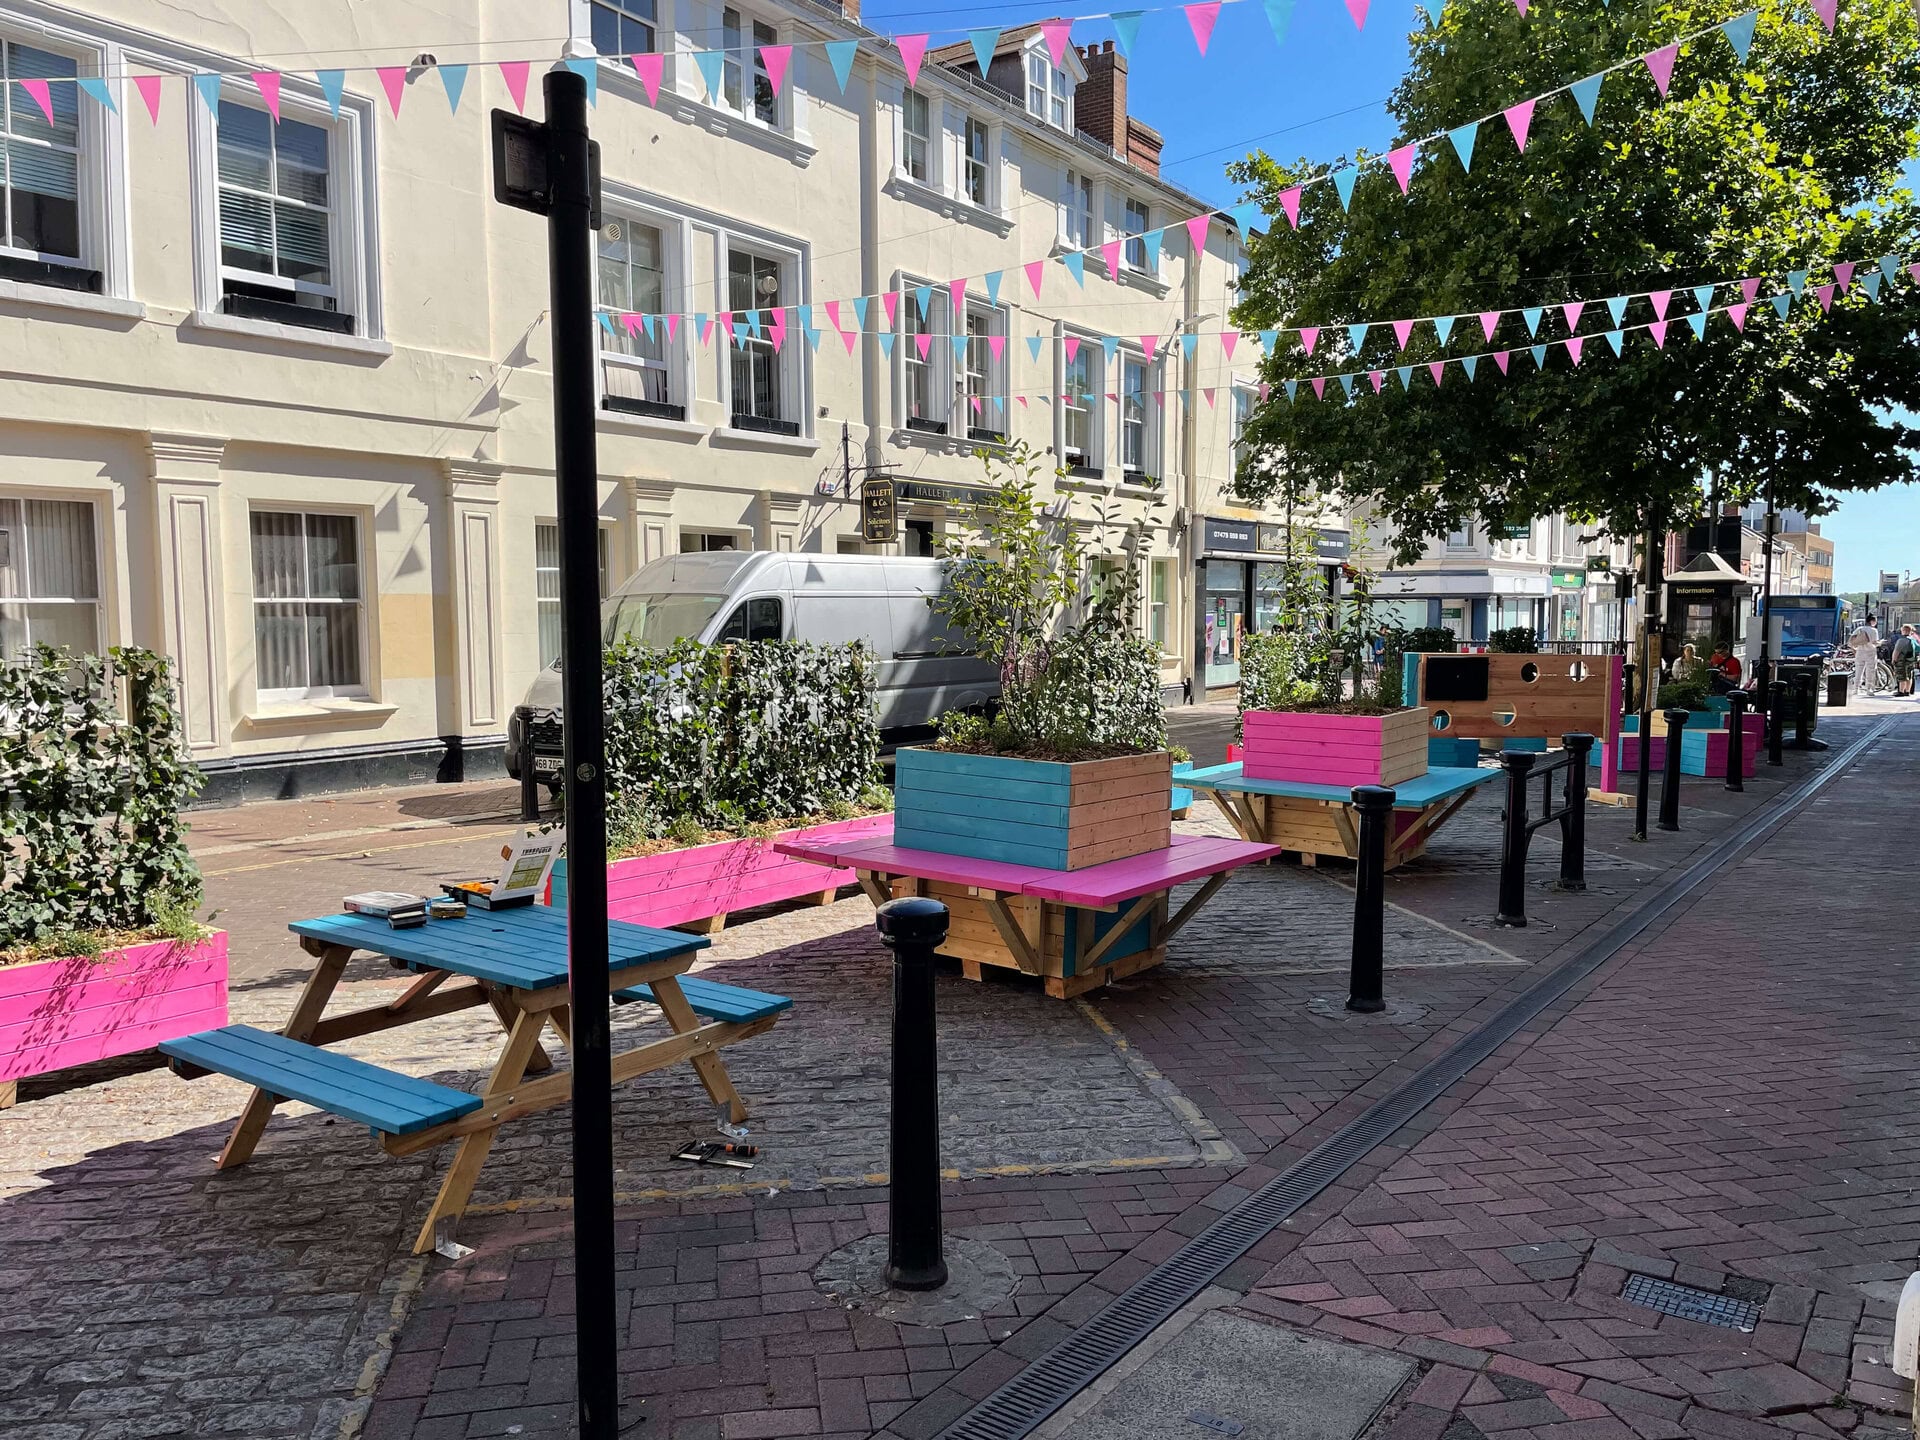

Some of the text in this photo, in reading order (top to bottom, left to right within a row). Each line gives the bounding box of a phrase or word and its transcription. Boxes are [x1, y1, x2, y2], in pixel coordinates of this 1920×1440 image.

[864, 488, 891, 497] HALLETT
[916, 487, 973, 501] HALLETT &
[872, 499, 878, 507] &
[867, 518, 891, 526] Solicitors
